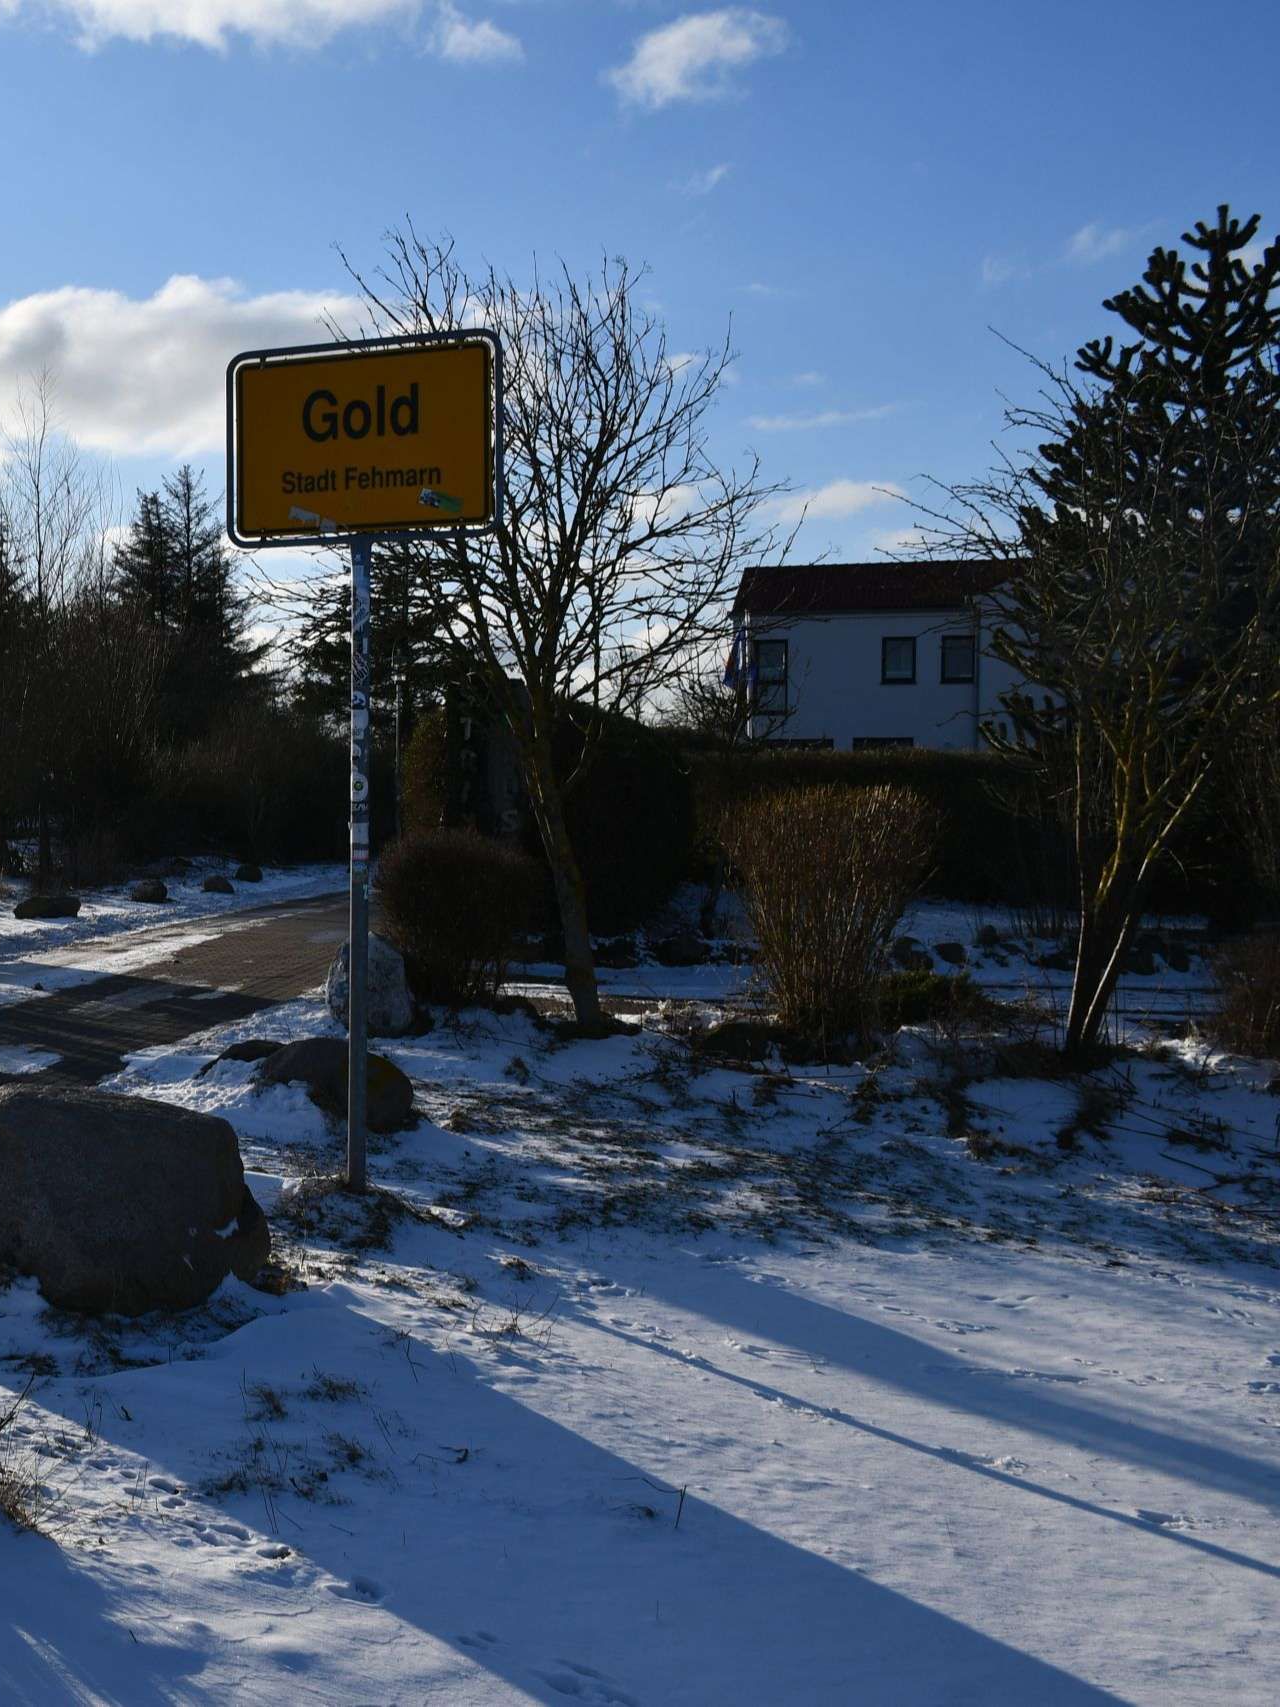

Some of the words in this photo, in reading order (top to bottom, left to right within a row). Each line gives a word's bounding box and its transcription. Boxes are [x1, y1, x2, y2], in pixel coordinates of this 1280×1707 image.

[302, 383, 419, 442] Gold
[282, 469, 337, 494] Stadt
[344, 466, 442, 491] Fehmarn
